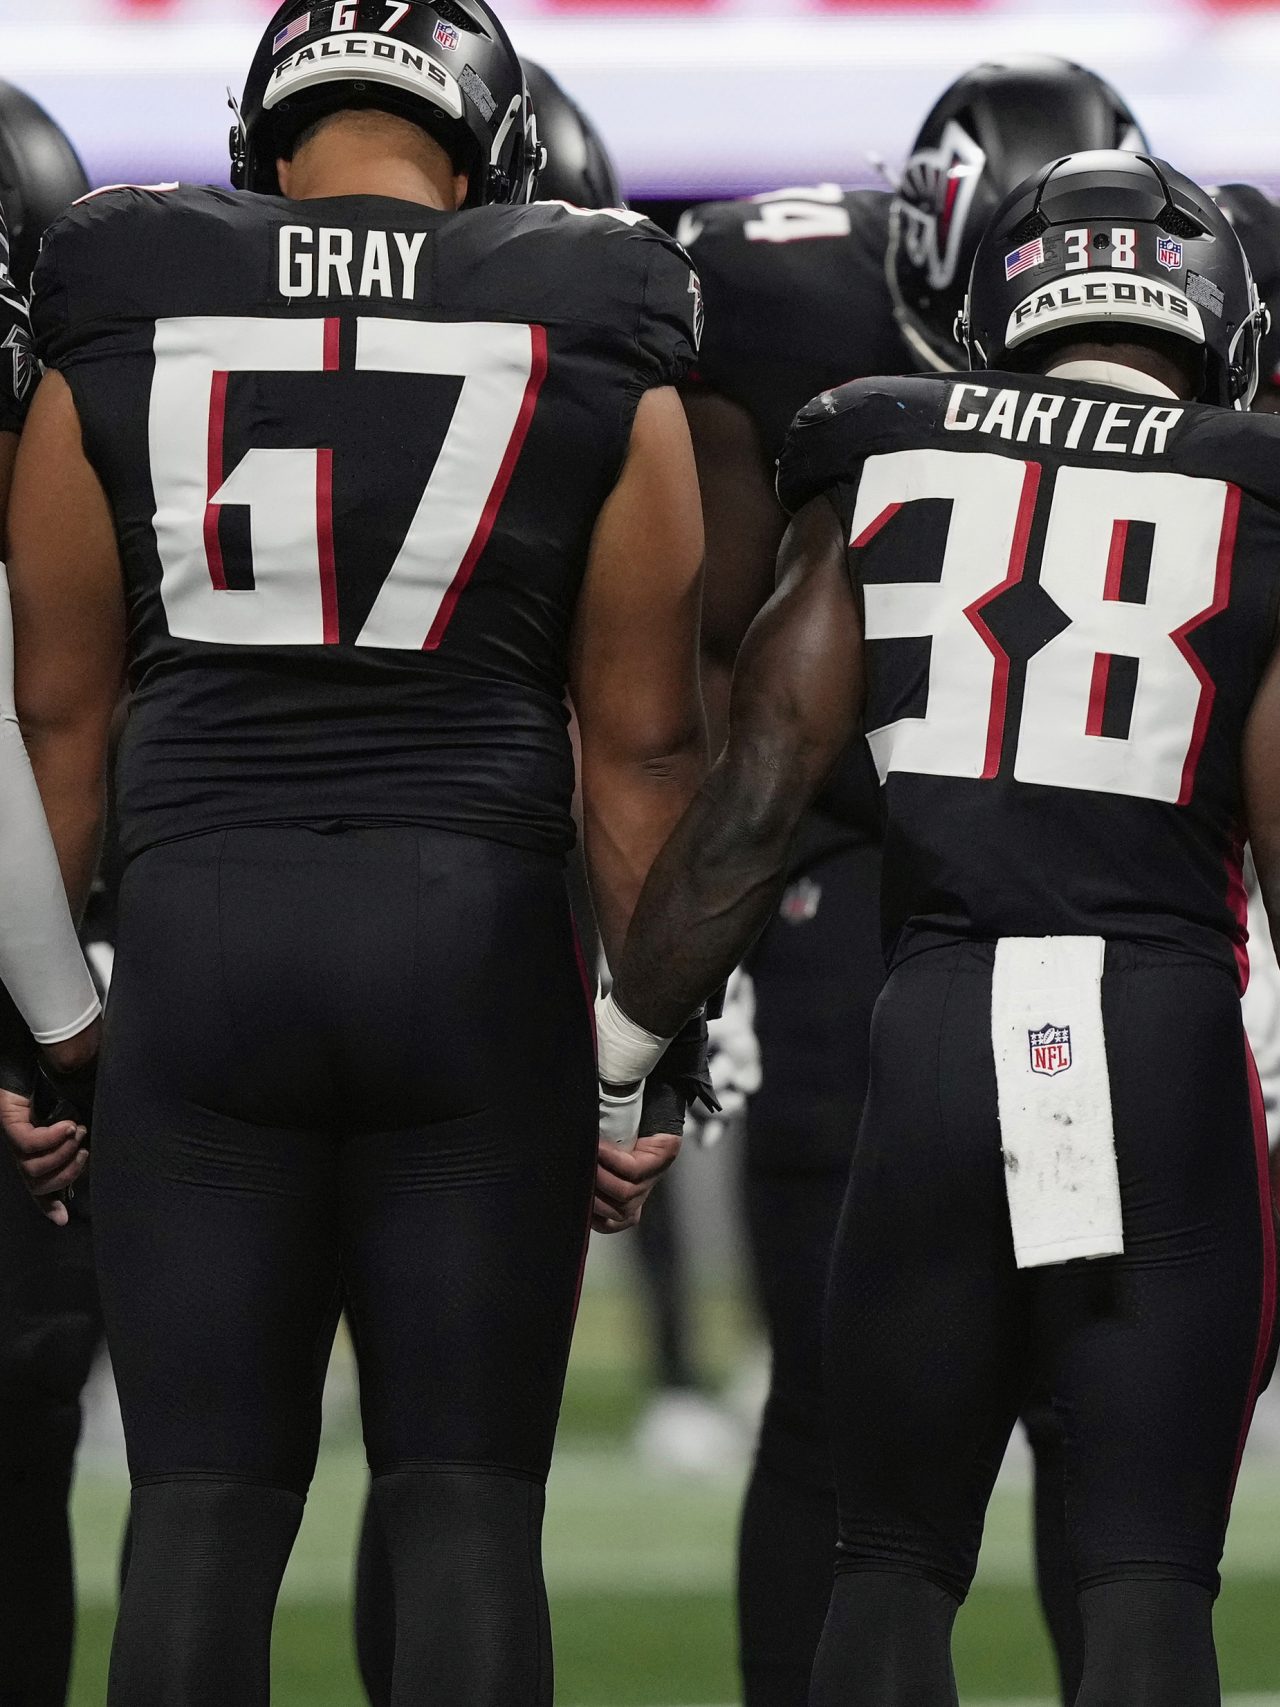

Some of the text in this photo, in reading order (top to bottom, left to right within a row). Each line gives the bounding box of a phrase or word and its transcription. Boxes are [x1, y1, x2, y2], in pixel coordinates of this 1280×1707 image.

[330, 0, 412, 32] 67
[435, 30, 457, 49] NFL
[274, 39, 447, 87] FALCONS
[279, 225, 426, 299] GRAY
[1064, 228, 1137, 271] 38
[1159, 251, 1180, 267] NFL
[1014, 283, 1189, 324] FALCONS
[944, 384, 1185, 455] CARTER
[148, 316, 548, 651] 67
[848, 448, 1242, 807] 38
[1034, 1045, 1068, 1071] NFL
